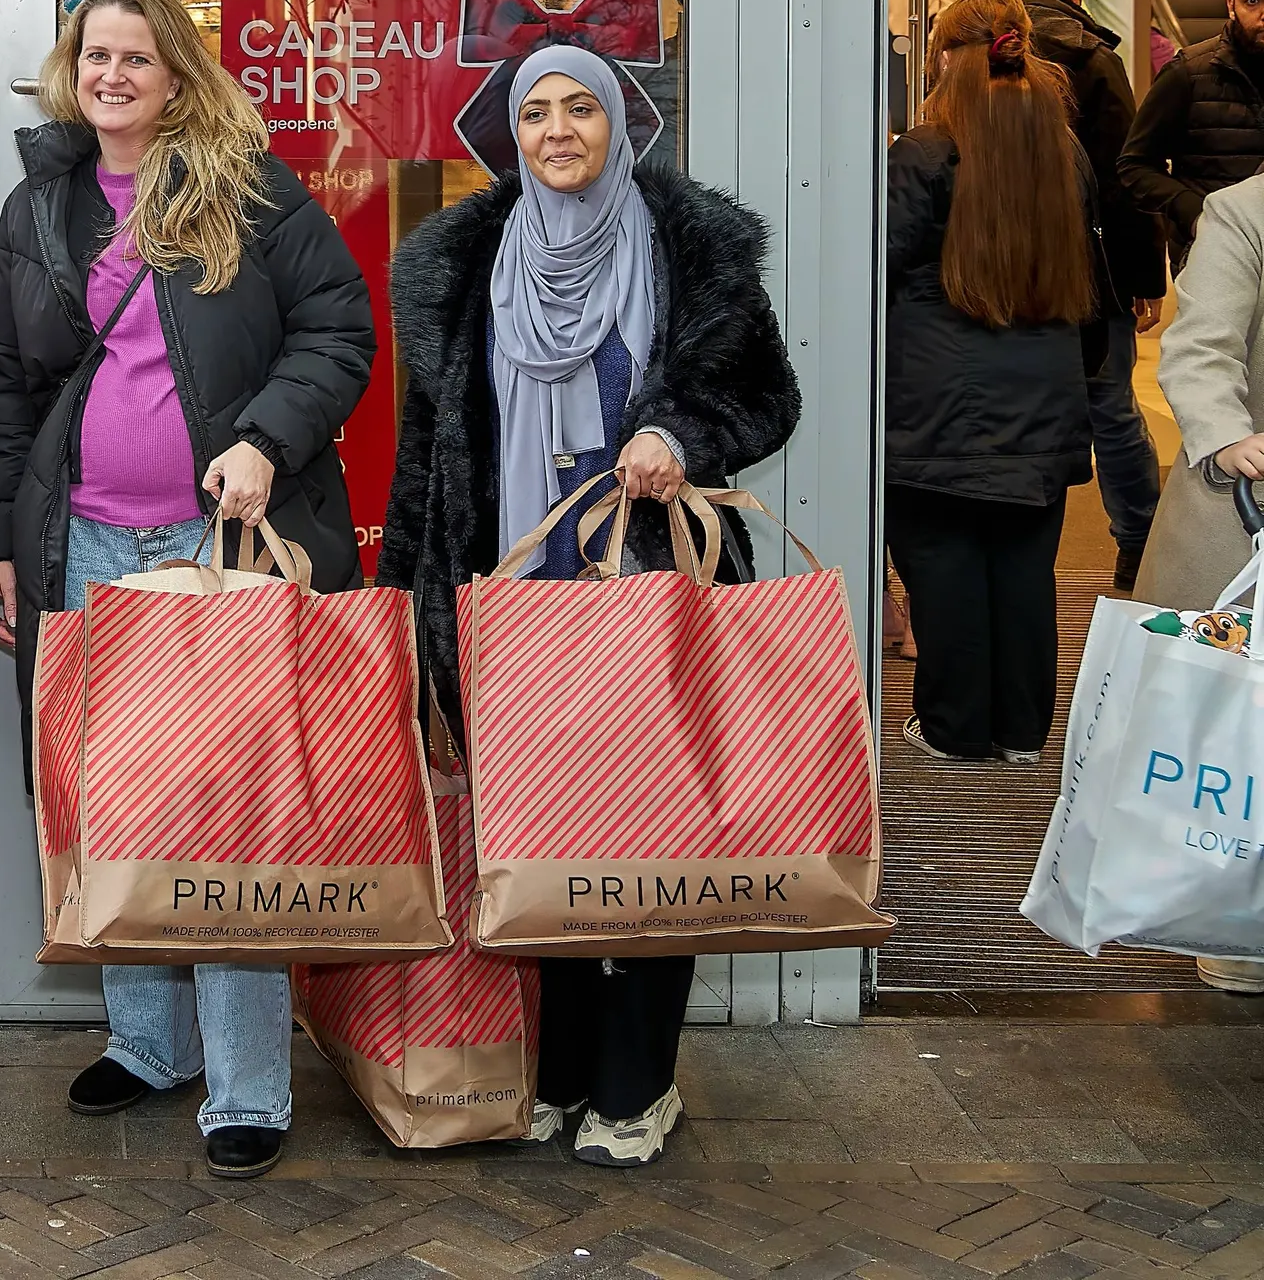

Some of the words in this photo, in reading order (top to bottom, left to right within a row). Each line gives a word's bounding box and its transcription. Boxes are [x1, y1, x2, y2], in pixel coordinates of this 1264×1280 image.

[238, 19, 445, 60] CADEAU
[239, 66, 382, 106] SHOP
[267, 117, 337, 133] geopend
[1143, 749, 1254, 821] PRI
[1185, 826, 1251, 860] LOVE
[162, 926, 195, 937] MADE
[197, 926, 230, 937] FROM
[232, 926, 262, 937] 100%
[264, 926, 319, 937] RECYCLED
[321, 927, 380, 938] POLYESTER
[562, 921, 599, 932] MADE
[601, 919, 637, 931] FROM
[639, 917, 672, 929] 100%
[675, 915, 737, 928] RECYCLED
[740, 912, 809, 924] POLYESTER
[415, 1086, 517, 1107] primark.com
